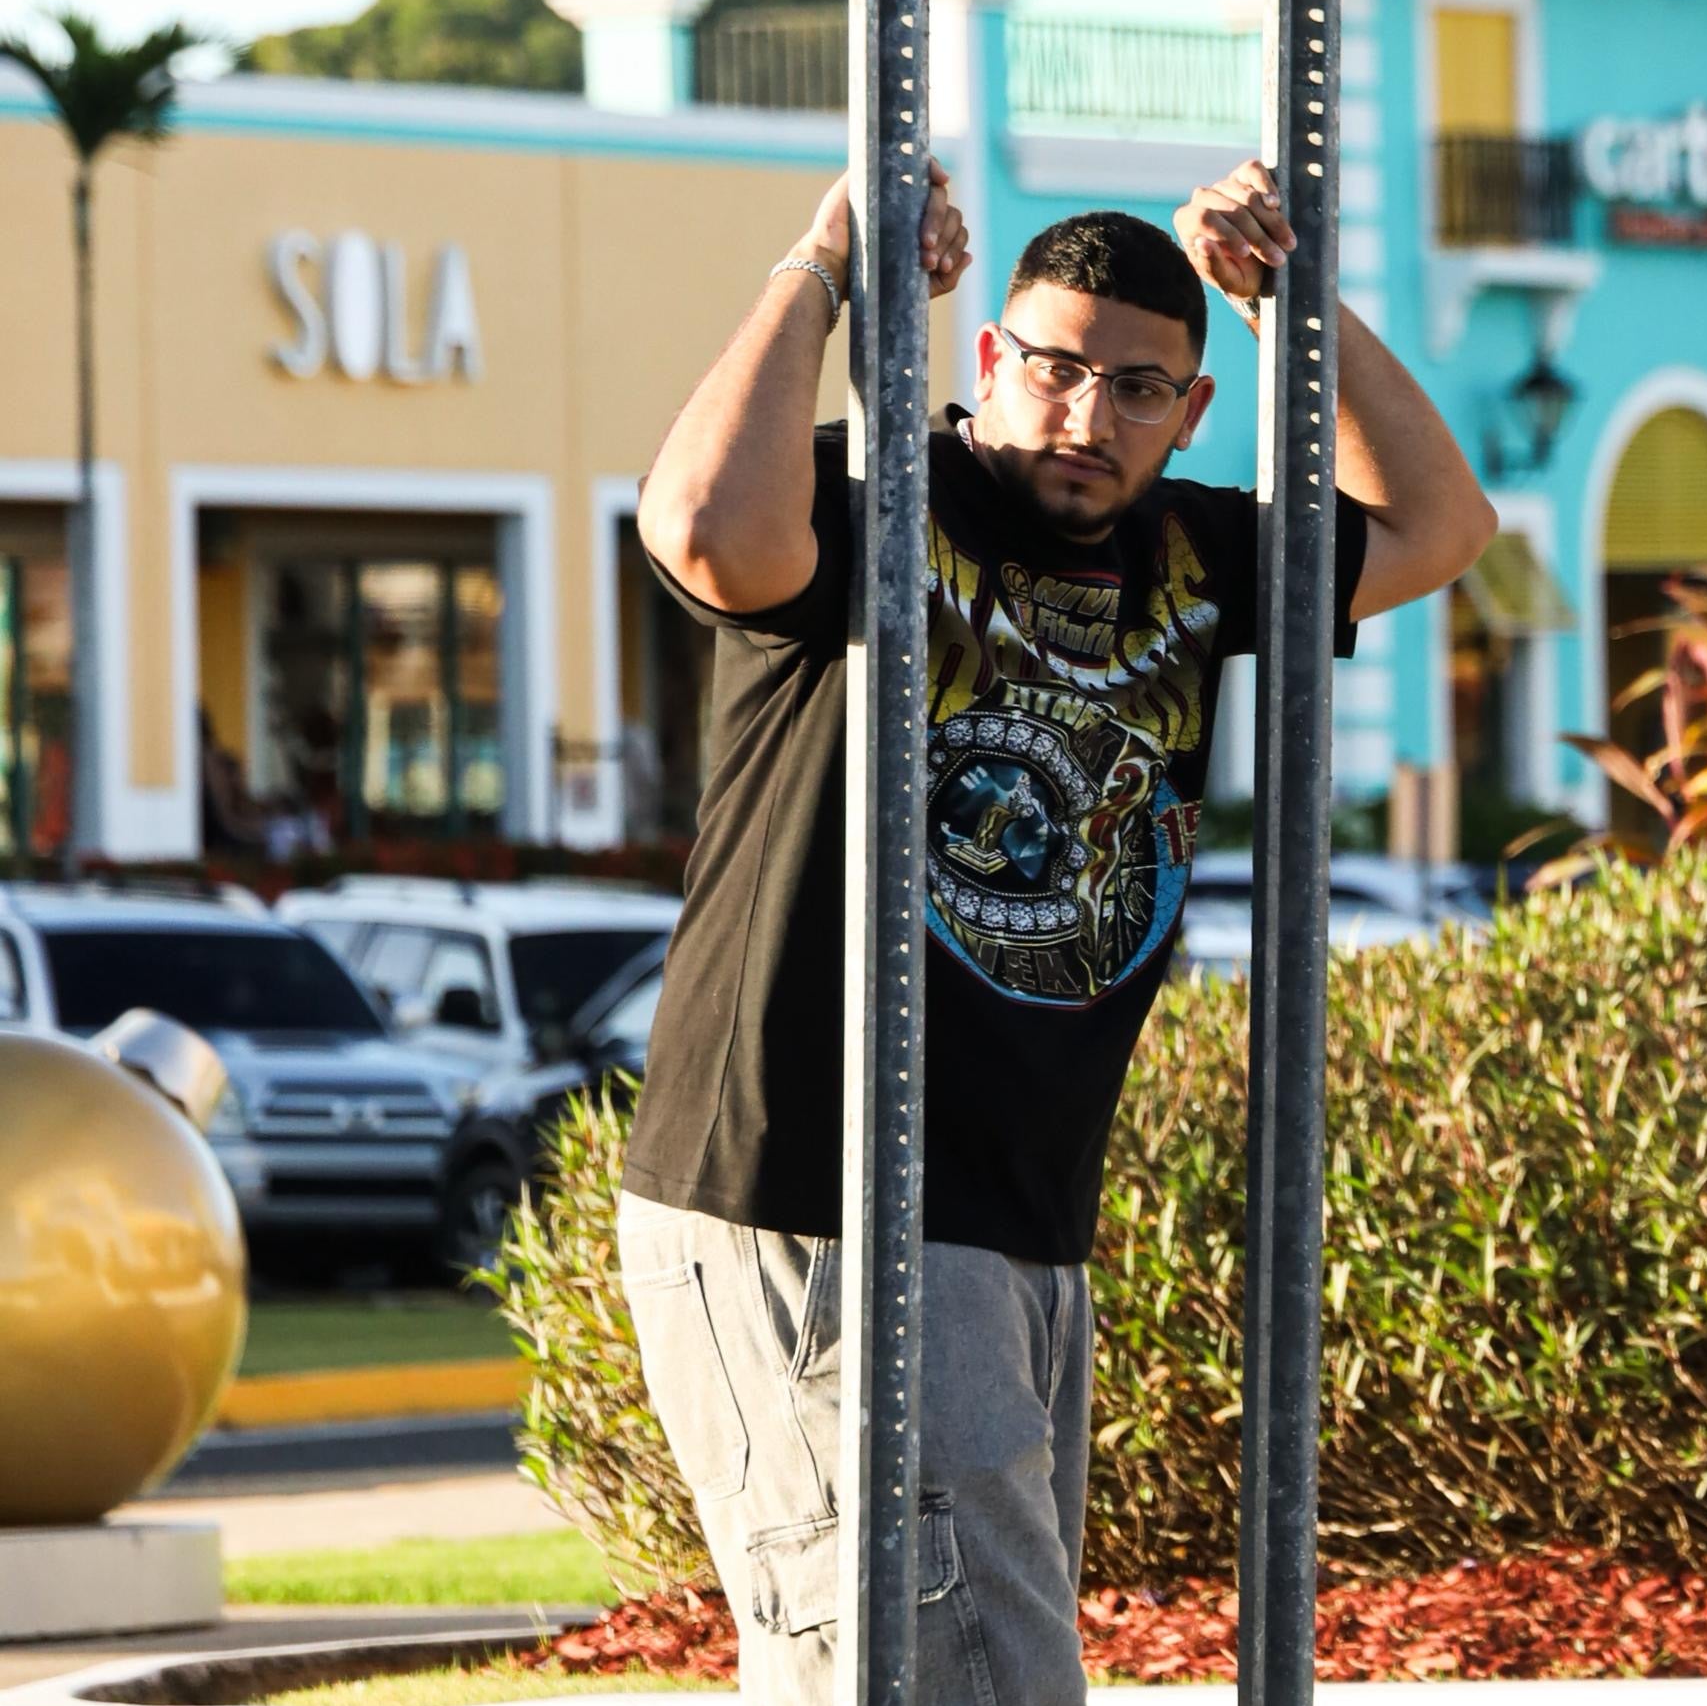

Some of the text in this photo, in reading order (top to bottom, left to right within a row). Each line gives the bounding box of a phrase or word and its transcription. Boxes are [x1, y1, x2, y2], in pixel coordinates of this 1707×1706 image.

[266, 228, 484, 384] SOLA
[1033, 575, 1120, 621] NIV
[1036, 606, 1115, 659] Fitnfl
